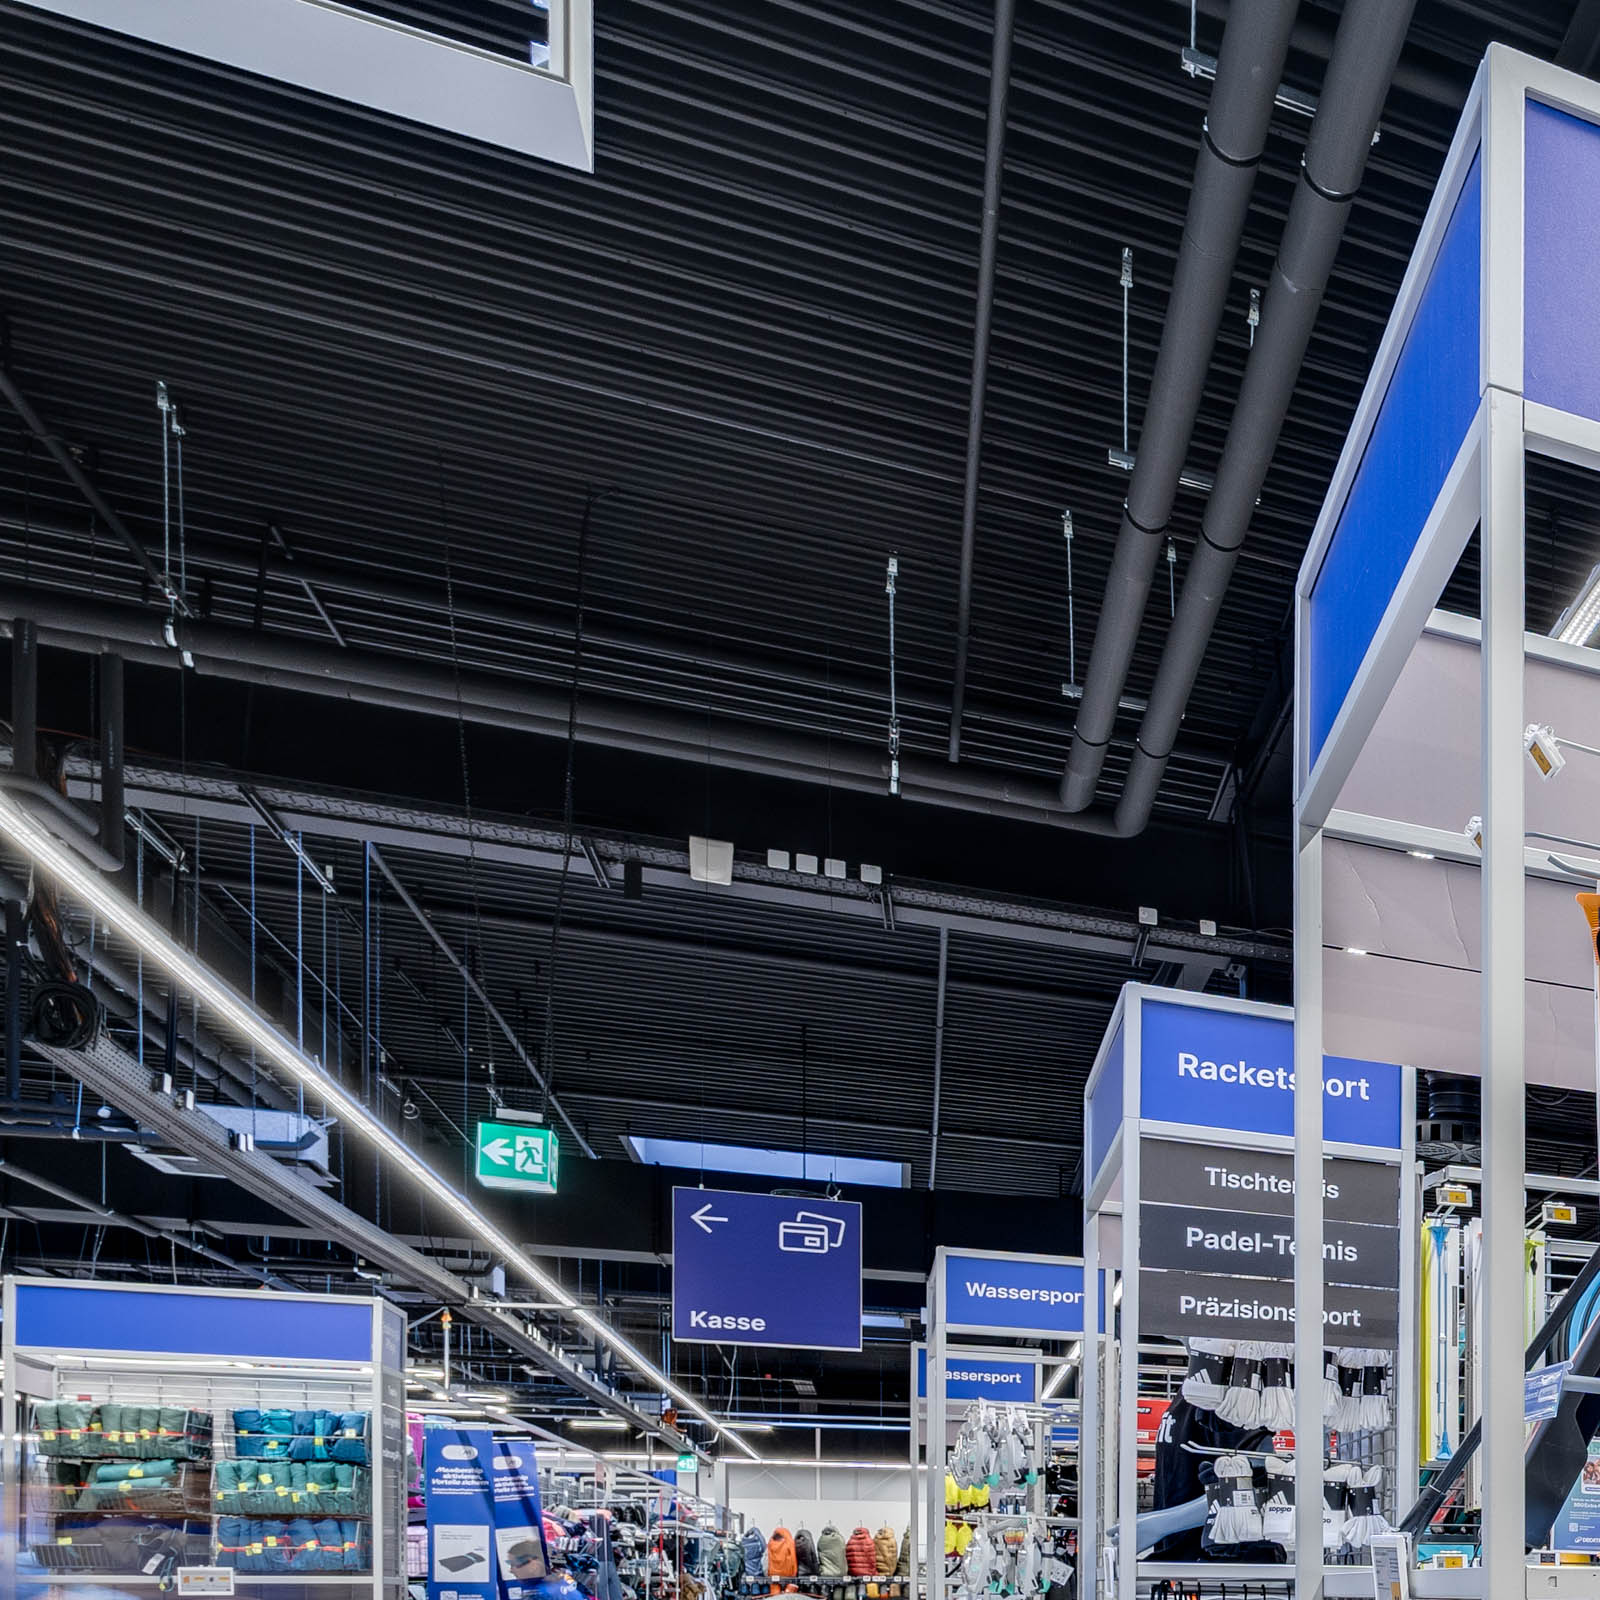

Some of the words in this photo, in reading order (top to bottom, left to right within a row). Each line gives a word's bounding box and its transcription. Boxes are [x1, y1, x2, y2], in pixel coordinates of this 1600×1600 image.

[1178, 1052, 1370, 1101] Racketsort
[1204, 1167, 1340, 1199] Tischteis
[1186, 1226, 1358, 1262] Padel-Tnis
[690, 1310, 766, 1333] Kasse
[1180, 1295, 1361, 1328] Präzisionsort
[945, 1369, 1022, 1387] assersport
